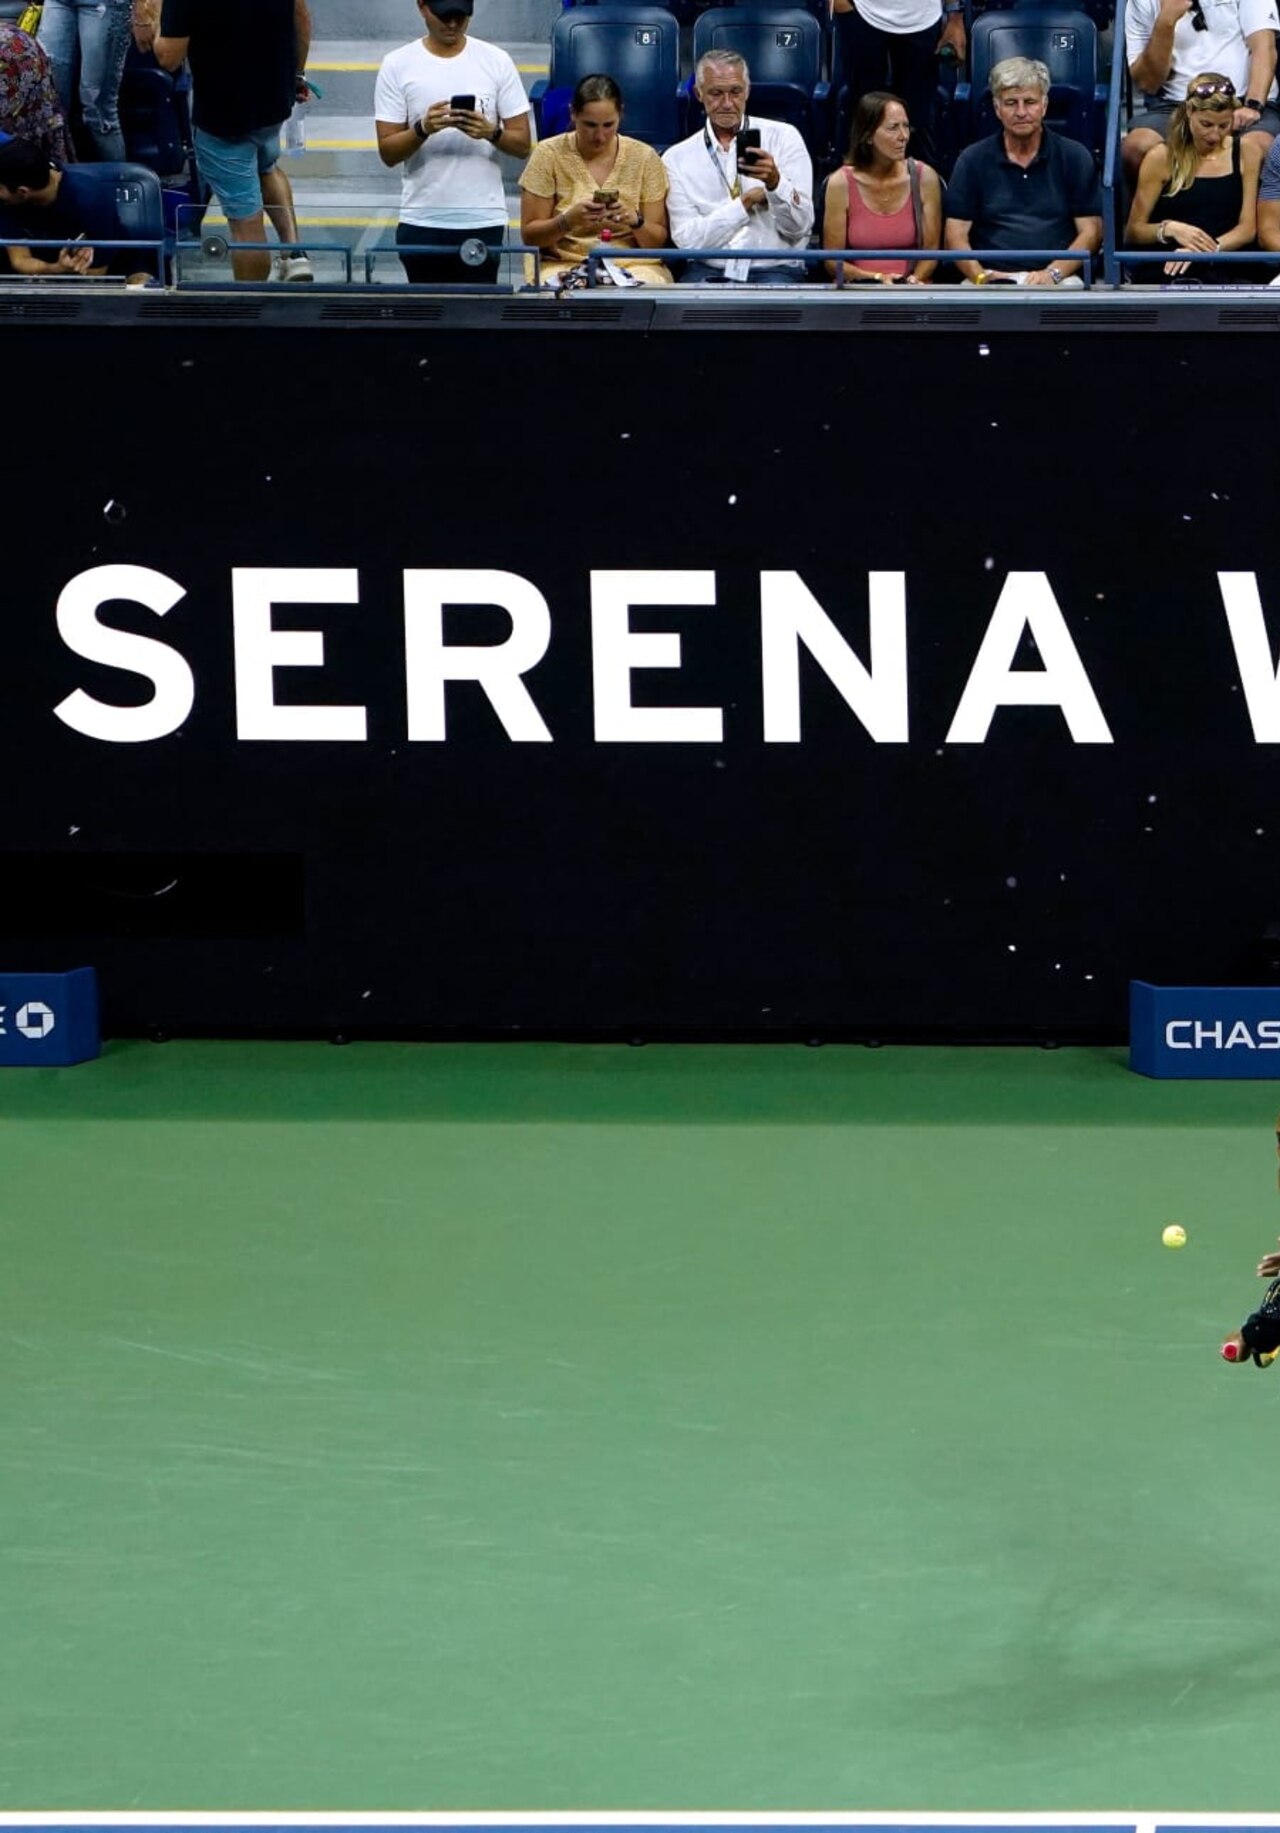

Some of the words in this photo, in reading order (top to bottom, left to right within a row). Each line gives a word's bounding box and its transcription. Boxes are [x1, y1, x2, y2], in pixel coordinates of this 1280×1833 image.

[642, 32, 650, 44] 8
[784, 33, 792, 45] 7
[1060, 36, 1068, 48] 5
[54, 564, 1114, 744] SERENA
